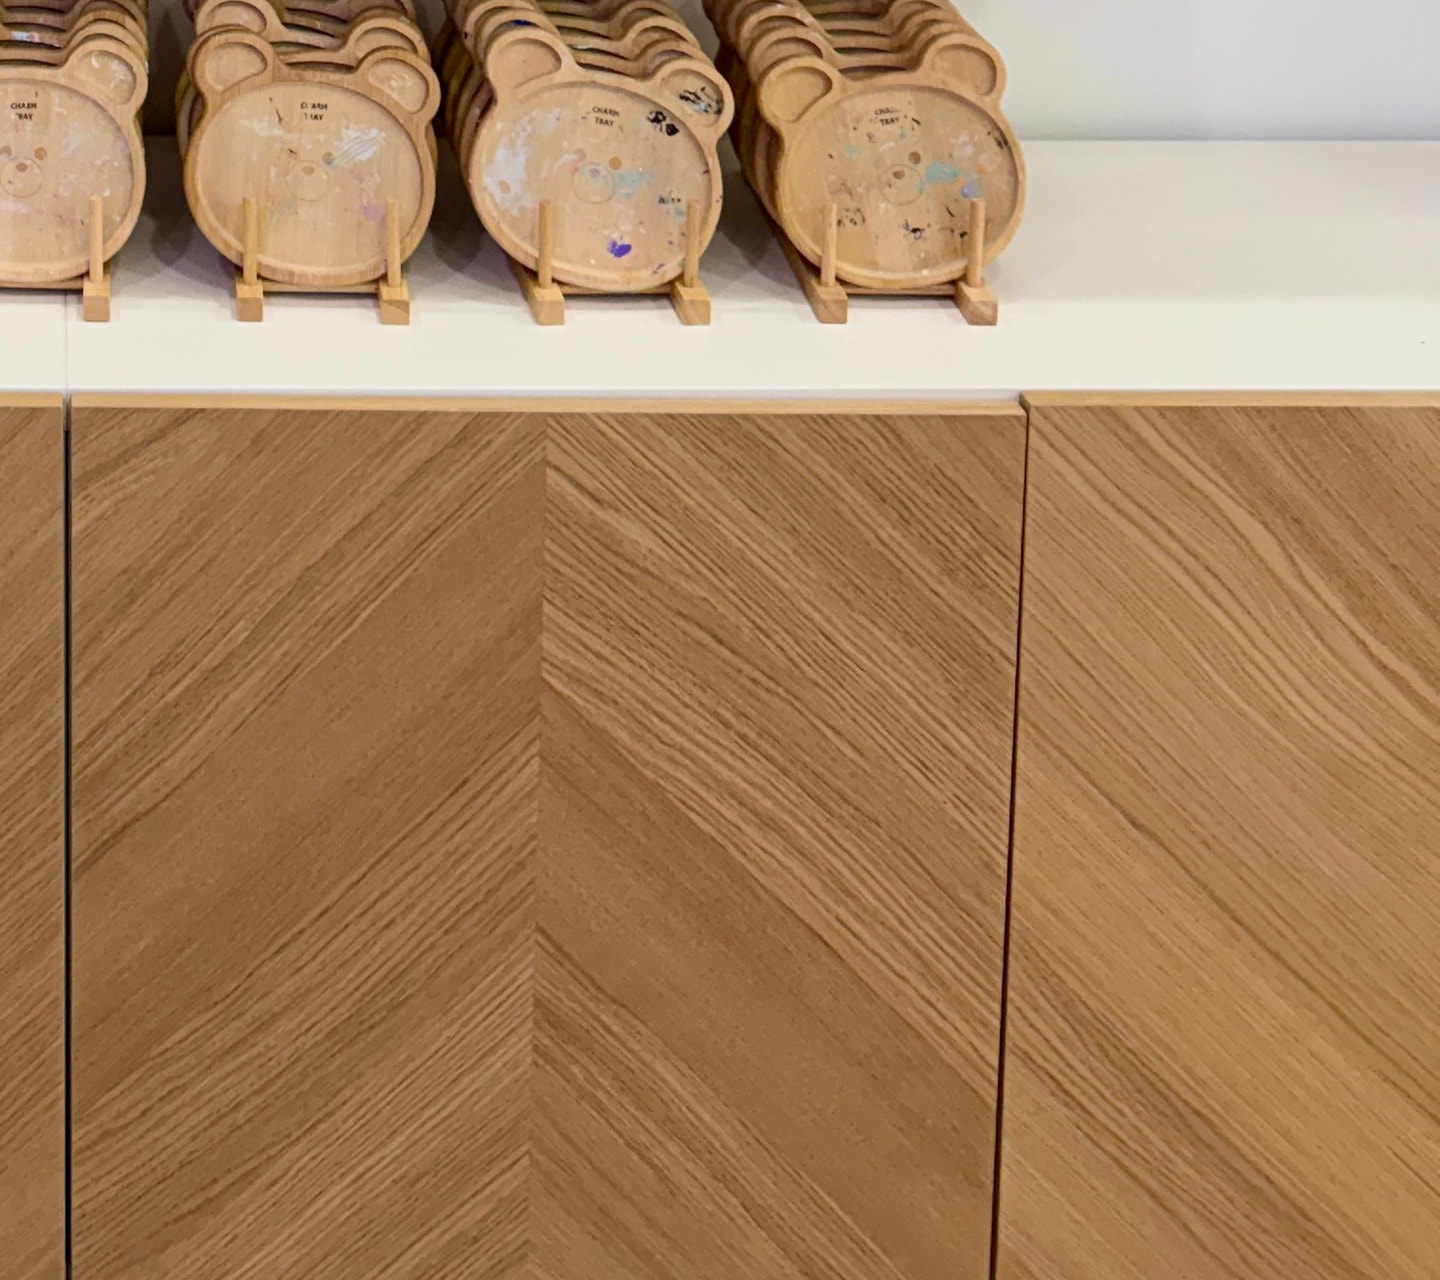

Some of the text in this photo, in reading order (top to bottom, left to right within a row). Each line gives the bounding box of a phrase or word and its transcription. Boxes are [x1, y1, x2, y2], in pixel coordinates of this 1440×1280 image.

[10, 102, 37, 110] CHARM
[300, 101, 328, 110] CARM
[592, 106, 619, 117] CHARM
[595, 116, 614, 127] TRAY
[880, 117, 899, 126] TRAY
